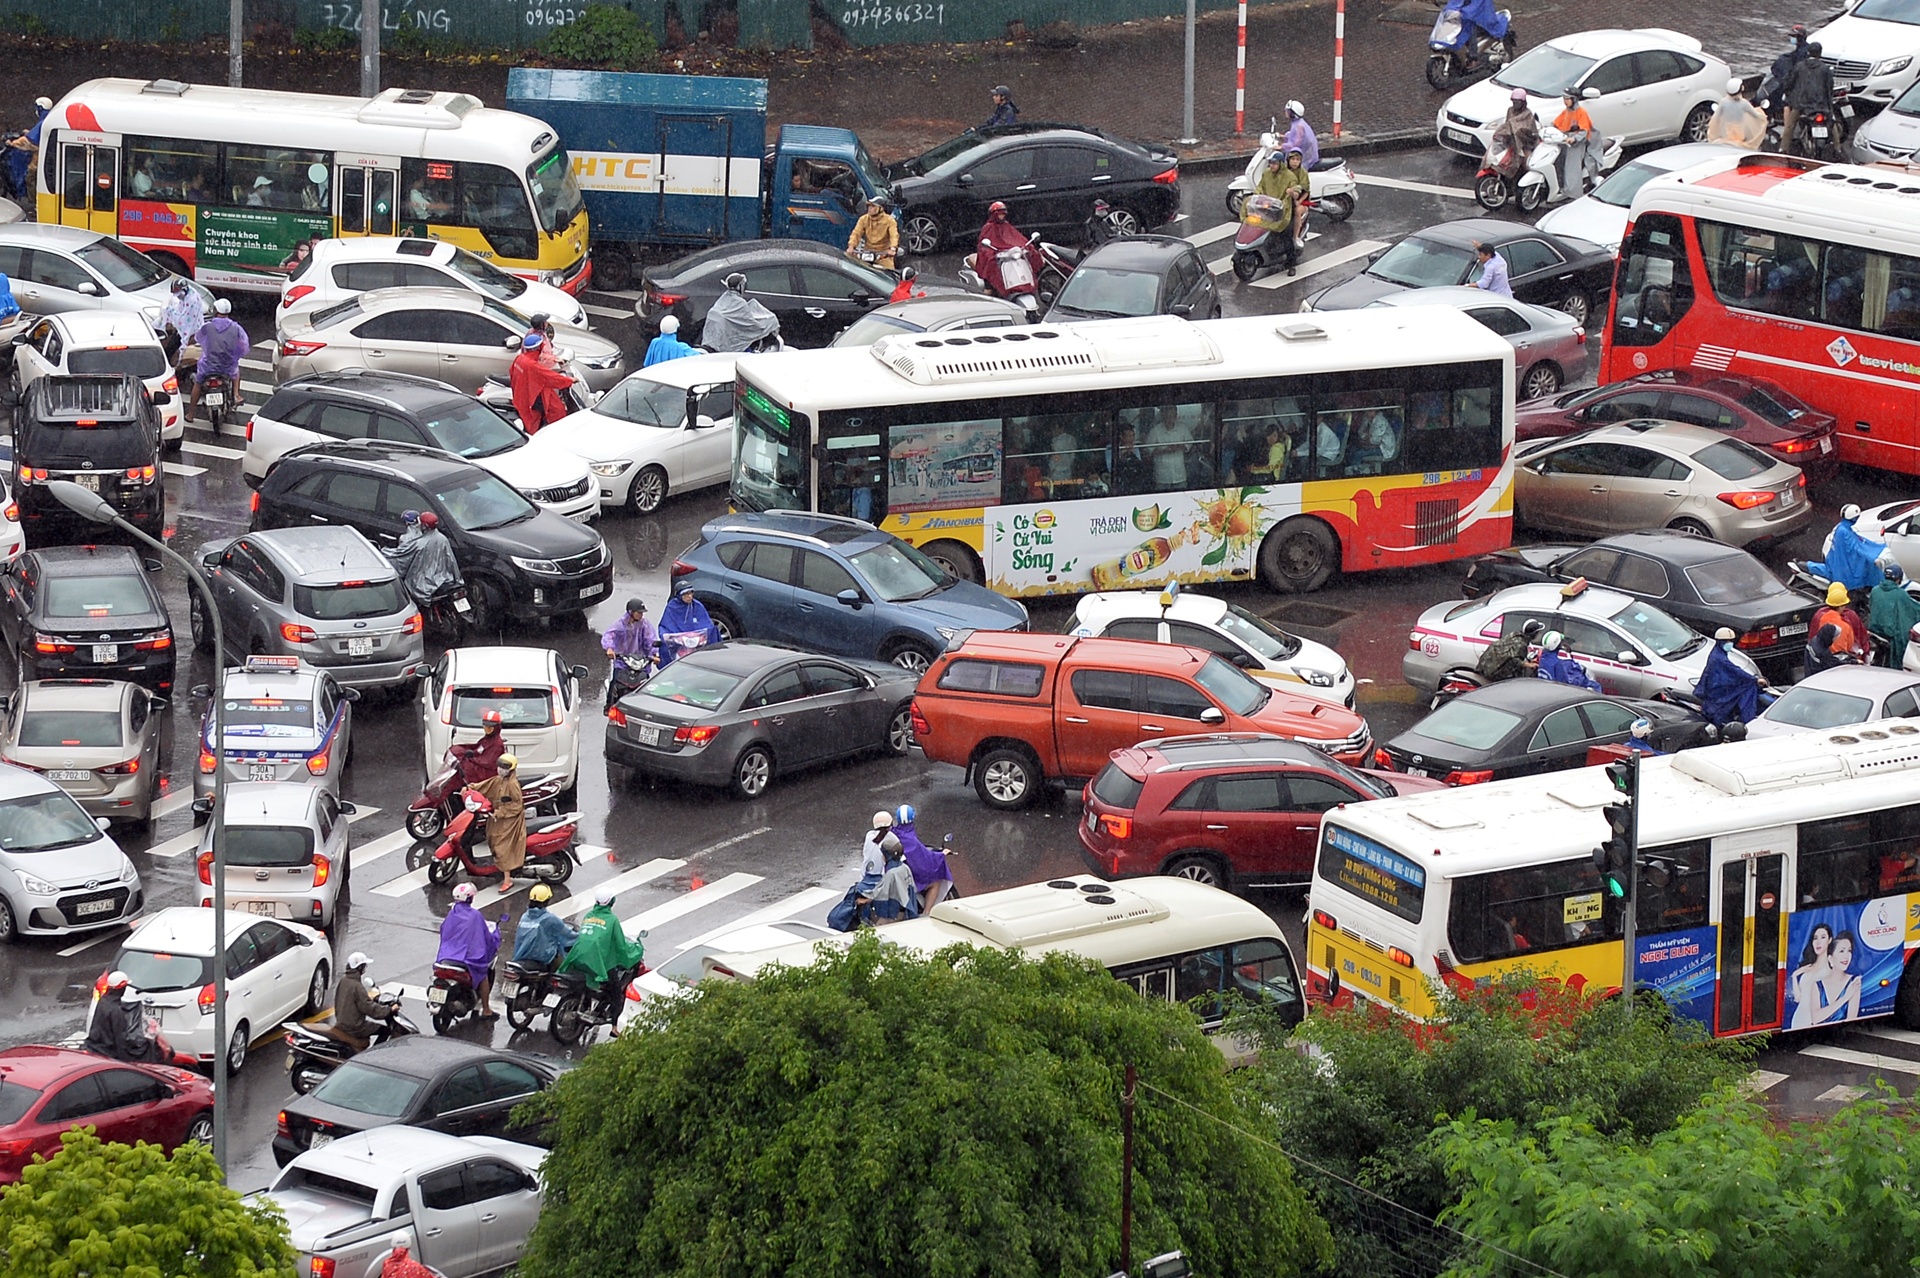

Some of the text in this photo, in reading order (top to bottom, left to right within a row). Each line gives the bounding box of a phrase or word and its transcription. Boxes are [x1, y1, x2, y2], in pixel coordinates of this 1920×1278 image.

[382, 8, 451, 33] LNG
[843, 3, 945, 29] 0974366321
[573, 156, 651, 179] HTC
[123, 210, 143, 221] 29B
[205, 228, 260, 240] Chuyên khoa
[205, 246, 240, 257] Nam Nữ
[243, 240, 261, 250] sinh
[922, 516, 984, 530] HANOIBUS
[1013, 514, 1030, 530] Có
[1090, 515, 1127, 527] TRÀ ĐEN
[1098, 524, 1127, 535] CHANH
[1013, 530, 1054, 547] Cứ Vui
[1012, 547, 1055, 574] Sống
[1425, 642, 1440, 655] 923
[255, 765, 269, 773] 30A
[1327, 830, 1335, 842] 30
[1566, 903, 1600, 916] KHNG
[1640, 943, 1699, 964] NGỌC DUNG
